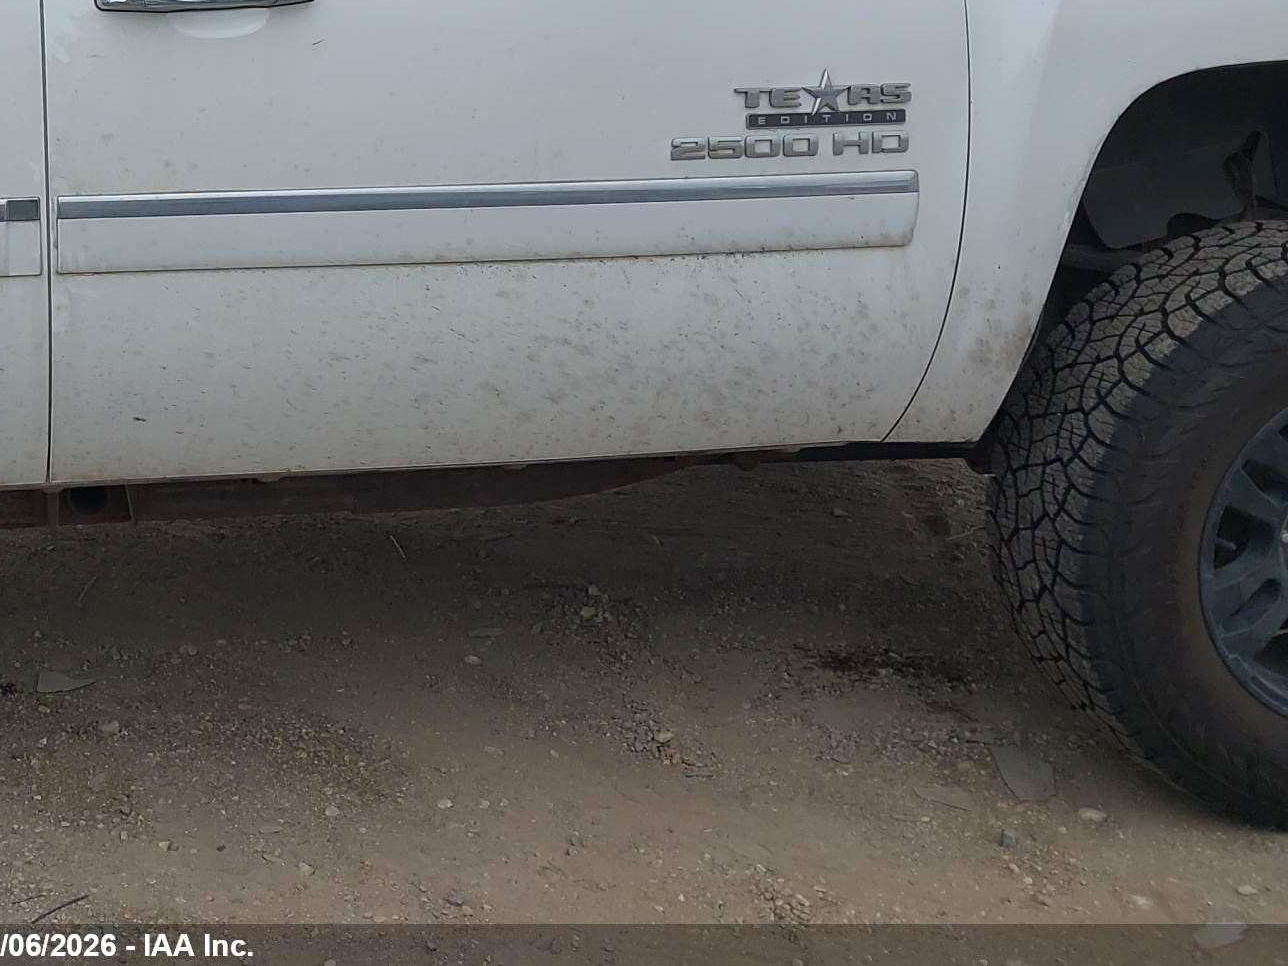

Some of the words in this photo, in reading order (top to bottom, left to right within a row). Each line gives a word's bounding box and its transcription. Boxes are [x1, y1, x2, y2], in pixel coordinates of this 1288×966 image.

[757, 111, 898, 126] EDITION
[670, 134, 819, 161] 2500
[832, 130, 910, 156] HD
